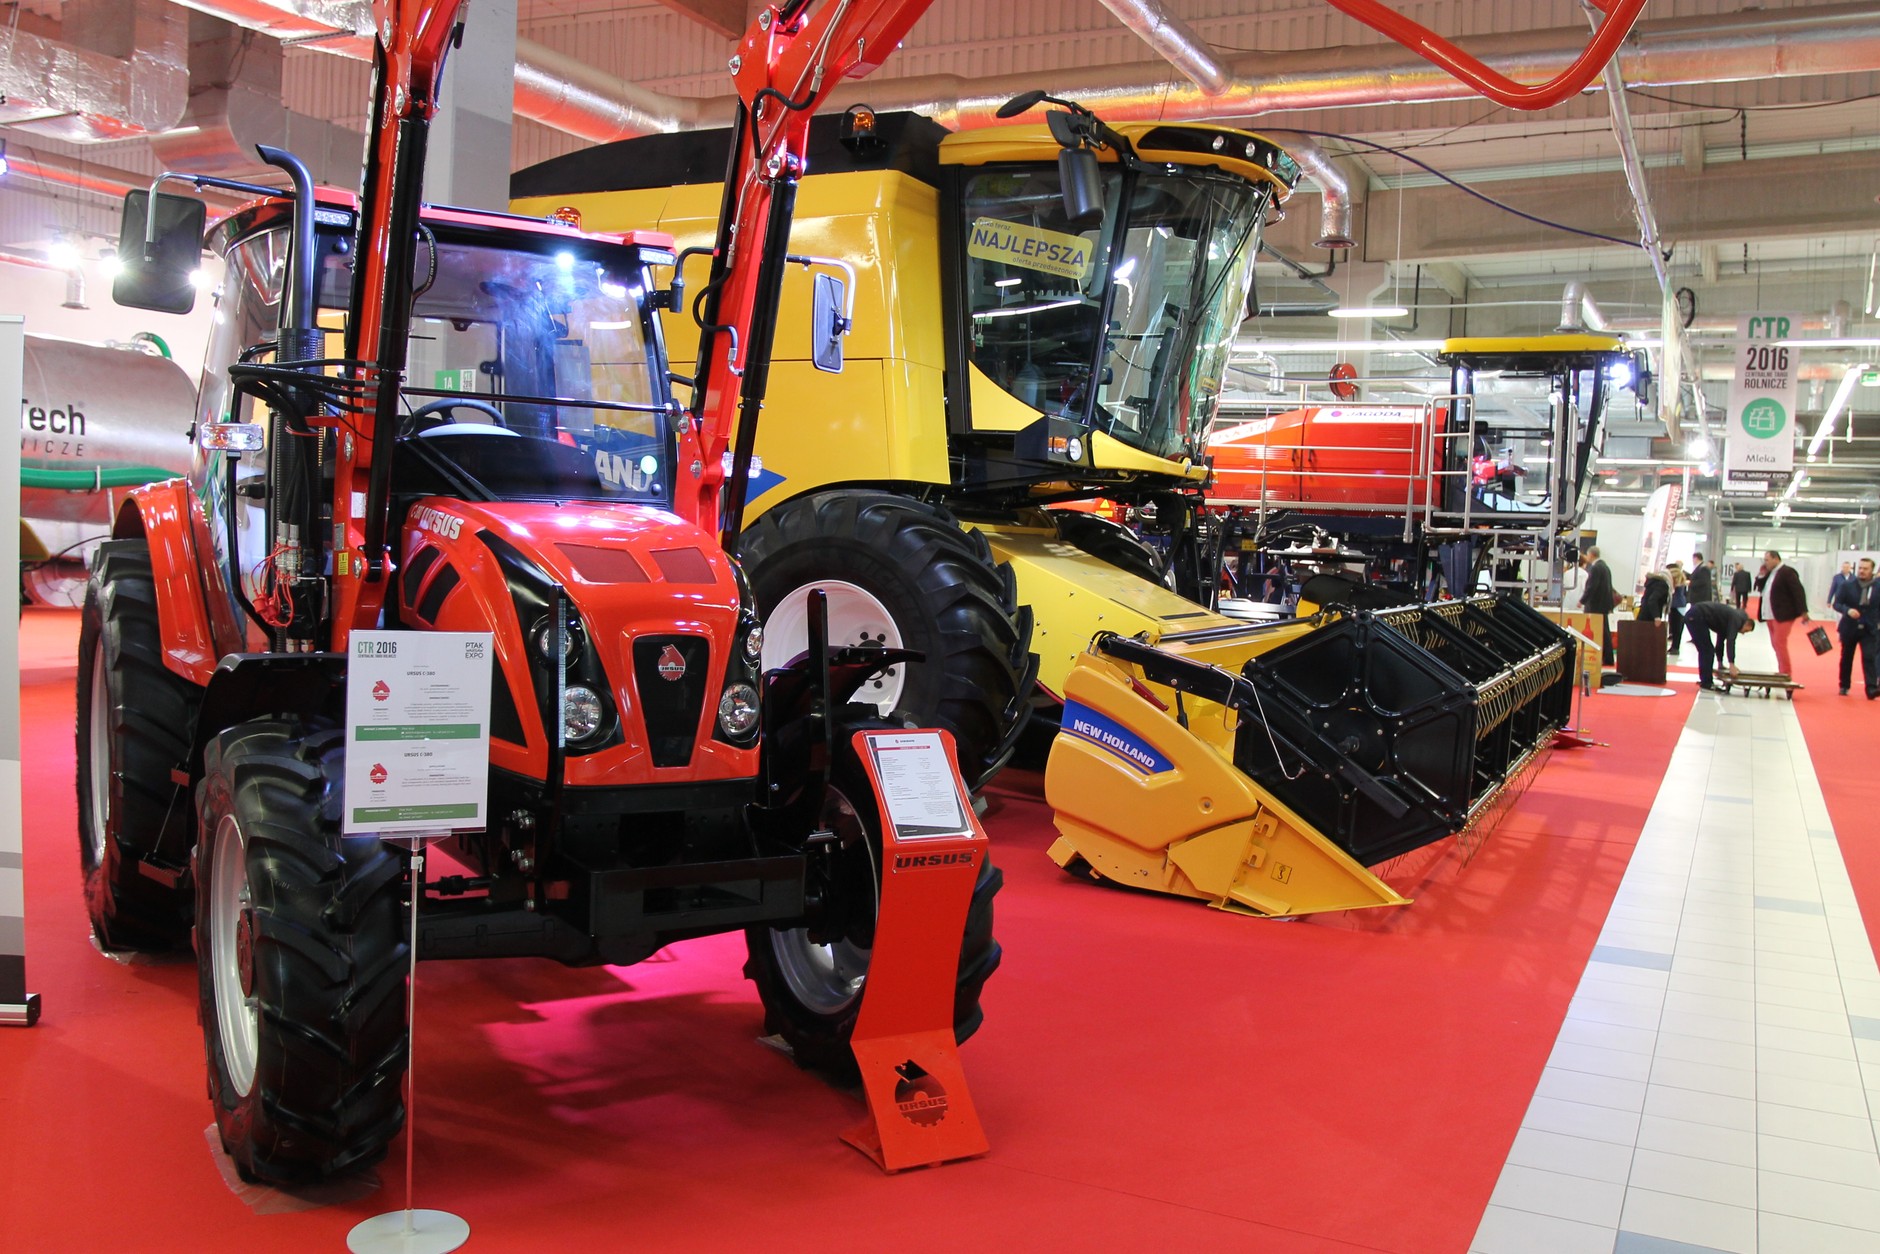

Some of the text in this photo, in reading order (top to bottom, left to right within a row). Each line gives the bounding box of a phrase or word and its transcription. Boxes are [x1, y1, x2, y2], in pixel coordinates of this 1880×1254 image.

[995, 222, 1011, 231] teraz
[973, 228, 1085, 268] NAJLEPSZA
[1012, 257, 1032, 266] oferta
[1746, 346, 1789, 371] 2016
[1744, 377, 1788, 389] ROLNICZE
[1745, 454, 1776, 463] Mleka
[418, 507, 465, 540] URSUS
[357, 641, 397, 654] CTR 2016
[1073, 719, 1156, 768] NEW HOLLAND
[896, 852, 972, 869] URSUS
[898, 1097, 947, 1111] URSUS
